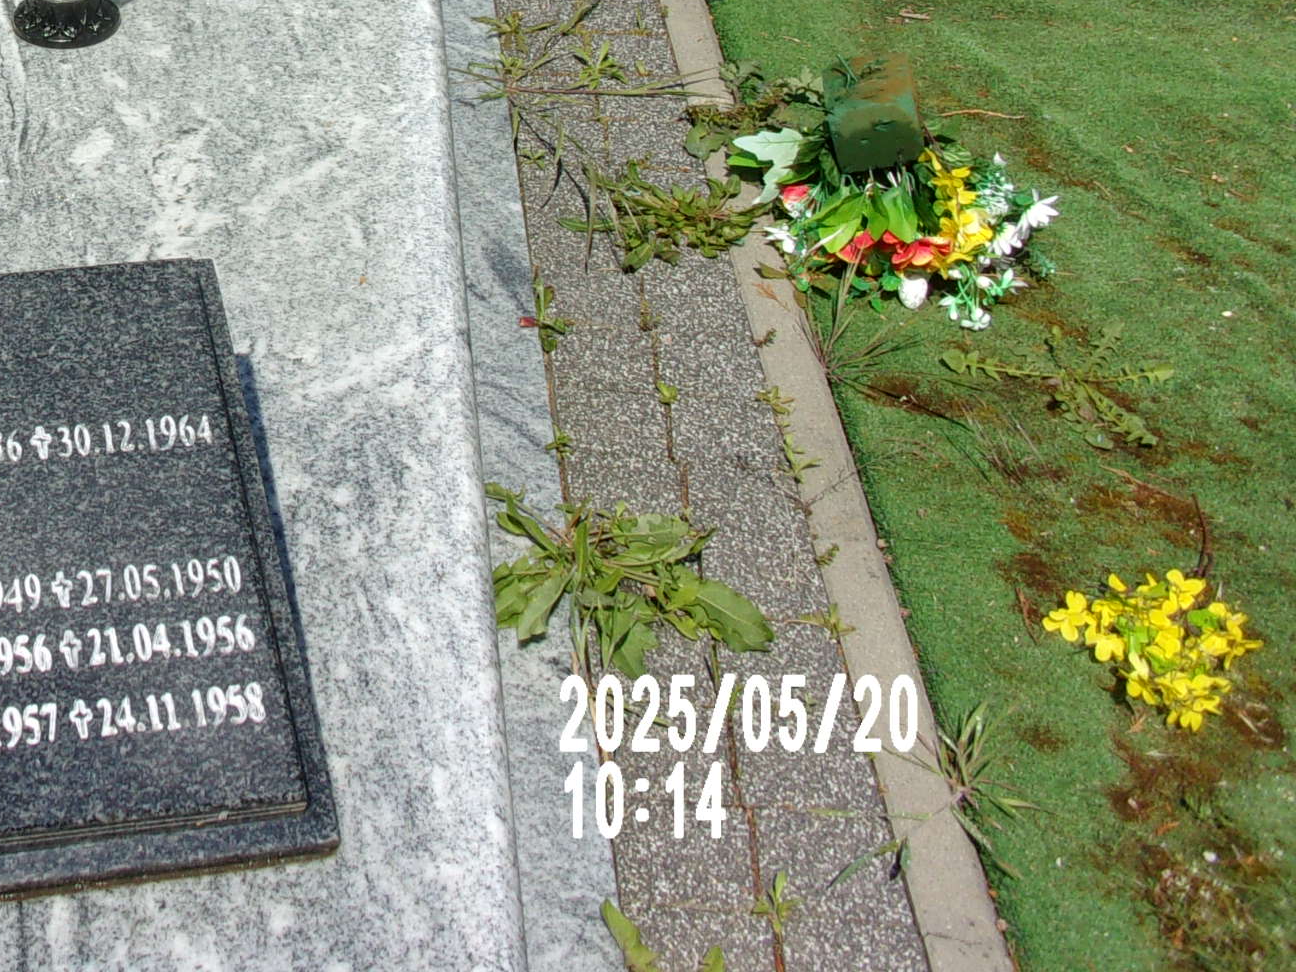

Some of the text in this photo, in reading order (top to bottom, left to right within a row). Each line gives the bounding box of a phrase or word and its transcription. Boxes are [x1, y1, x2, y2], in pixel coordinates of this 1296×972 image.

[58, 414, 212, 458] 30.12.1964
[77, 555, 241, 607] 27.05.1950
[87, 613, 256, 666] 21.04.1956
